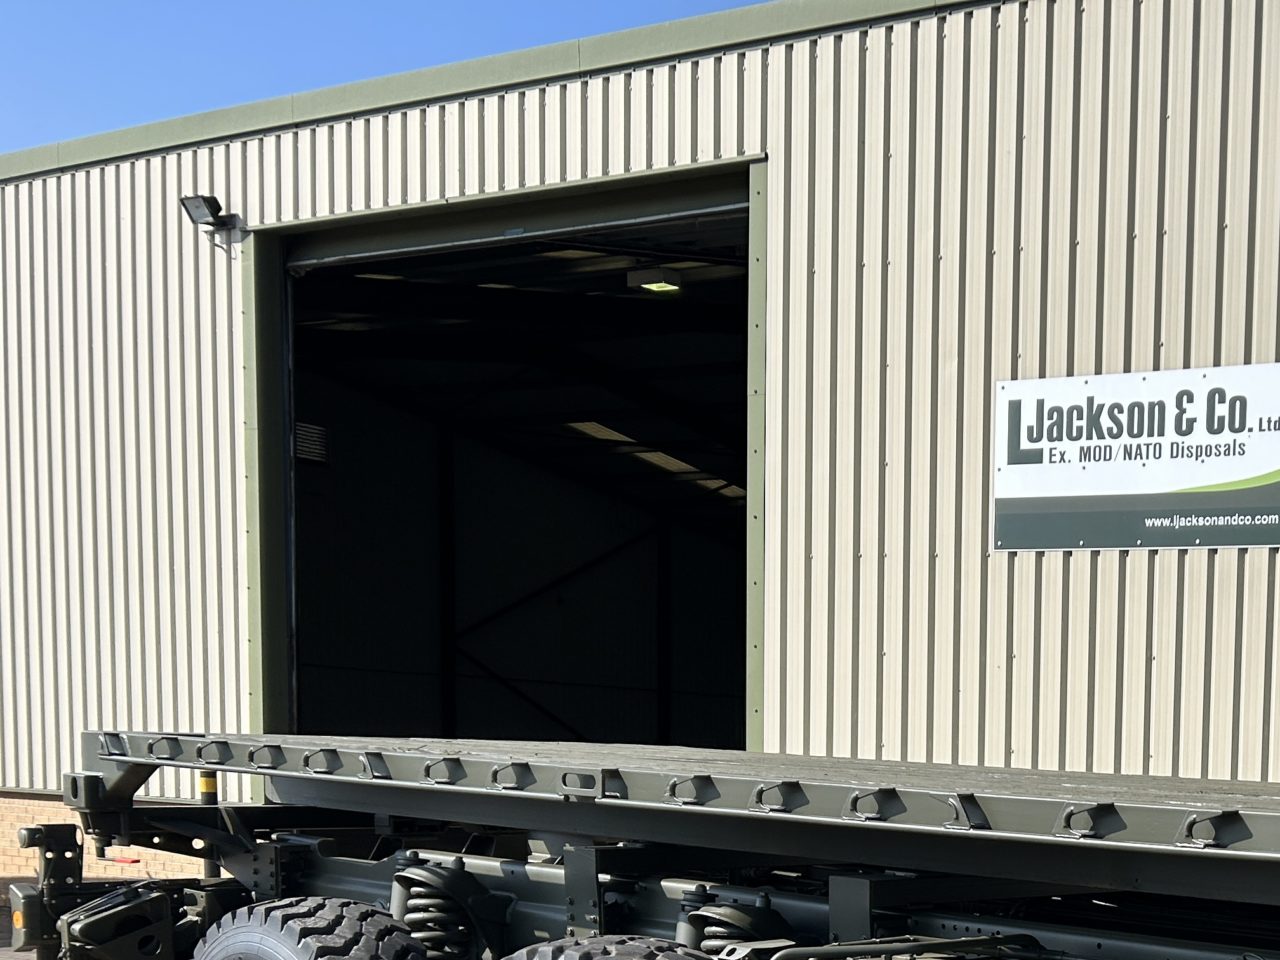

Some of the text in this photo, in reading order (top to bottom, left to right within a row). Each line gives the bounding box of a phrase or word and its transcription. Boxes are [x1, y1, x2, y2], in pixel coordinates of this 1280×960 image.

[1173, 389, 1198, 437] &
[1205, 386, 1254, 436] Co.
[1048, 438, 1247, 464] Ex. MOD/NATO Disposals
[1144, 512, 1280, 530] www.ljacksonandco.com
